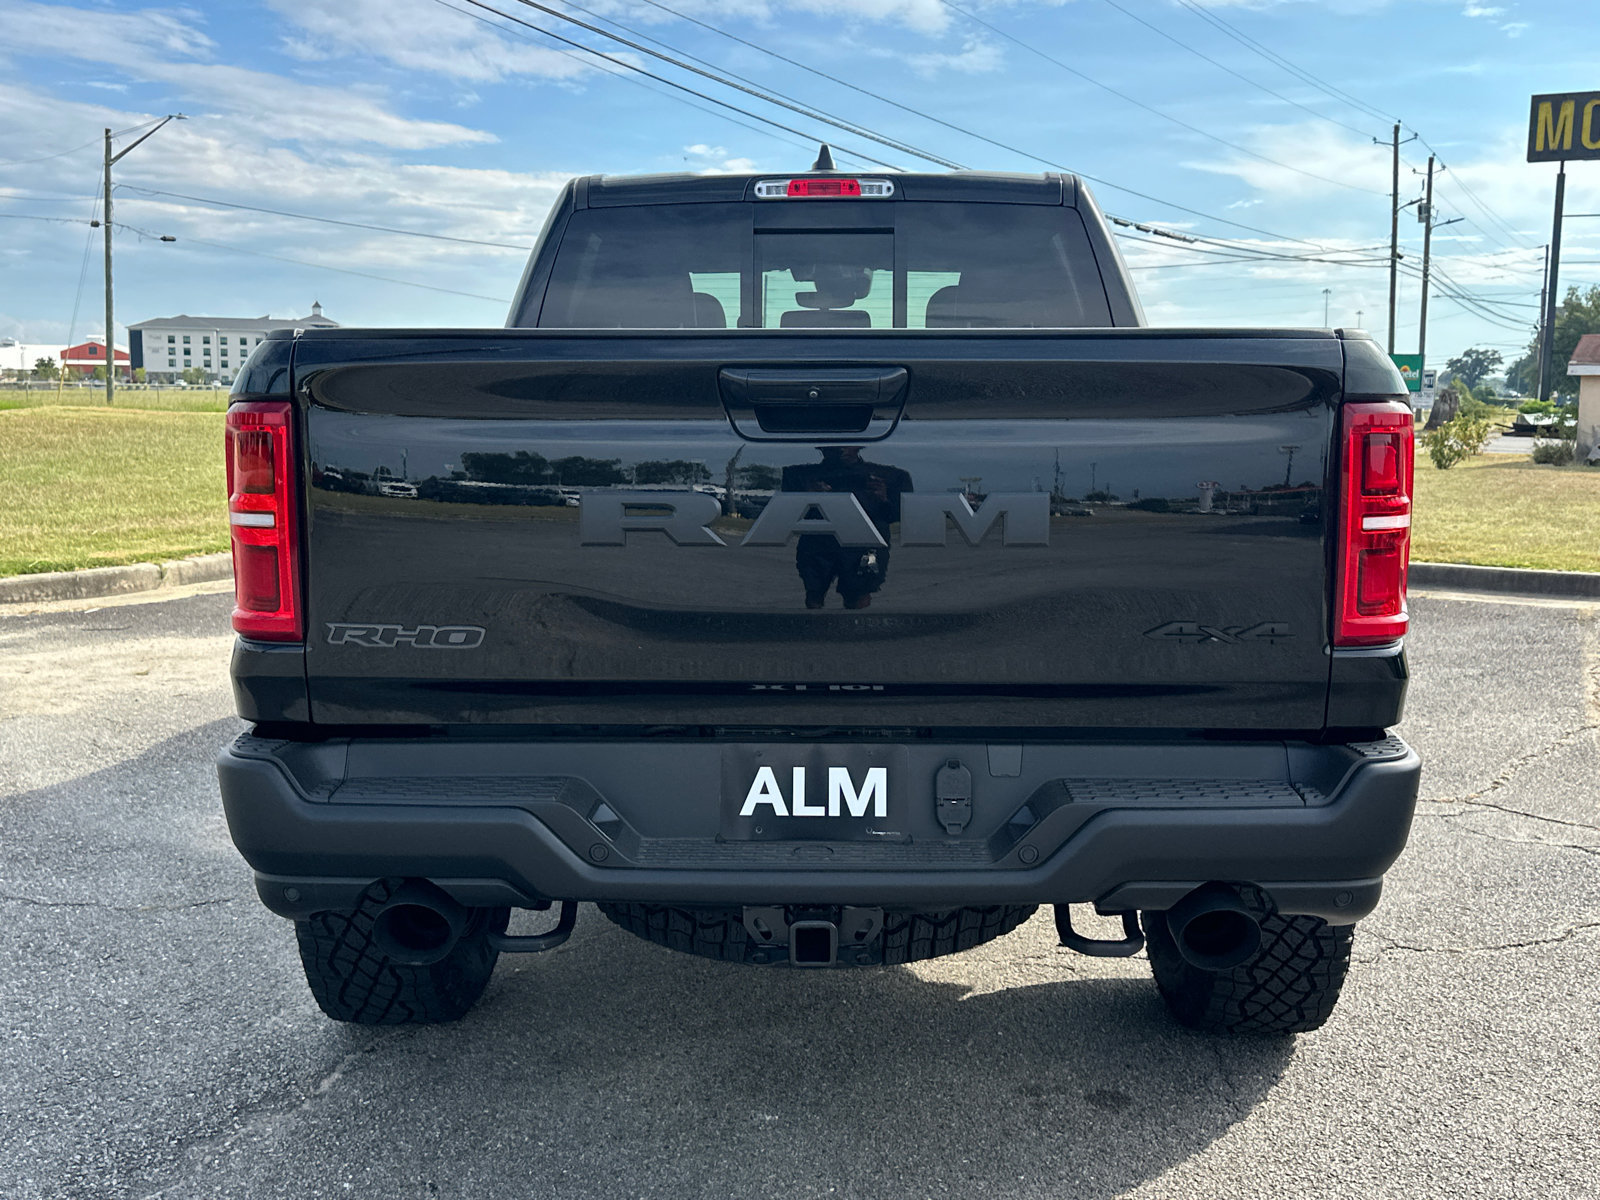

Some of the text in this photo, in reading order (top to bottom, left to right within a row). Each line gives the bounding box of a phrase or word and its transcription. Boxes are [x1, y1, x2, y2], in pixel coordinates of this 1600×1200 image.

[579, 491, 1050, 547] RAM
[326, 623, 487, 649] RHO
[739, 766, 888, 818] ALM
